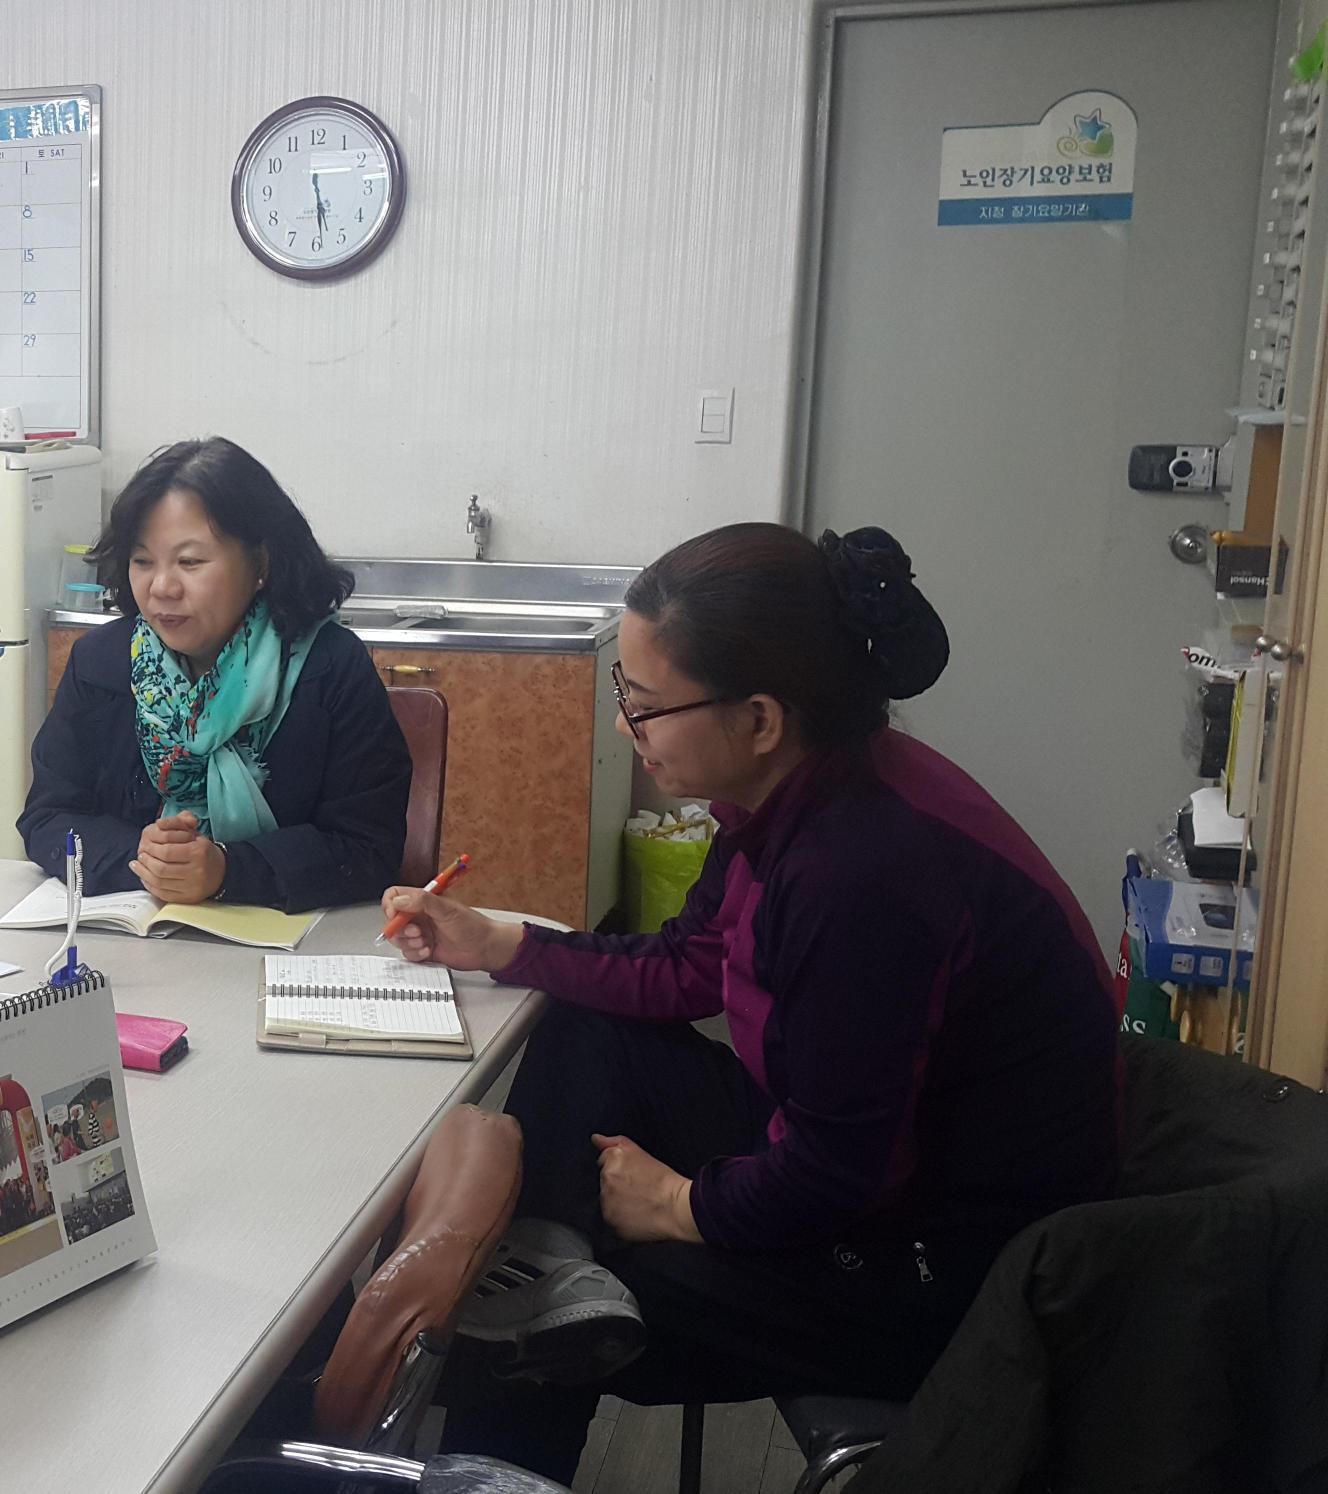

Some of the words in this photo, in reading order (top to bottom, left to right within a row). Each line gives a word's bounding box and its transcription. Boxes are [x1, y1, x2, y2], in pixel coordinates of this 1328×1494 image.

[288, 136, 298, 152] 11
[310, 128, 326, 146] 12
[342, 134, 347, 151] 1
[38, 150, 46, 158] 토
[50, 149, 64, 158] SAT
[357, 152, 366, 168] 2
[268, 158, 282, 174] 10
[960, 162, 1113, 188] 노인장기요양보험
[262, 186, 272, 202] 9
[364, 180, 372, 196] 3
[22, 205, 32, 218] 8
[268, 210, 278, 226] 8
[354, 208, 364, 222] 4
[288, 232, 296, 248] 7
[312, 236, 321, 252] 6
[336, 228, 346, 244] 5
[24, 249, 34, 262] 15
[24, 292, 36, 304] 22
[24, 335, 36, 346] 29
[1230, 576, 1265, 586] Hansol
